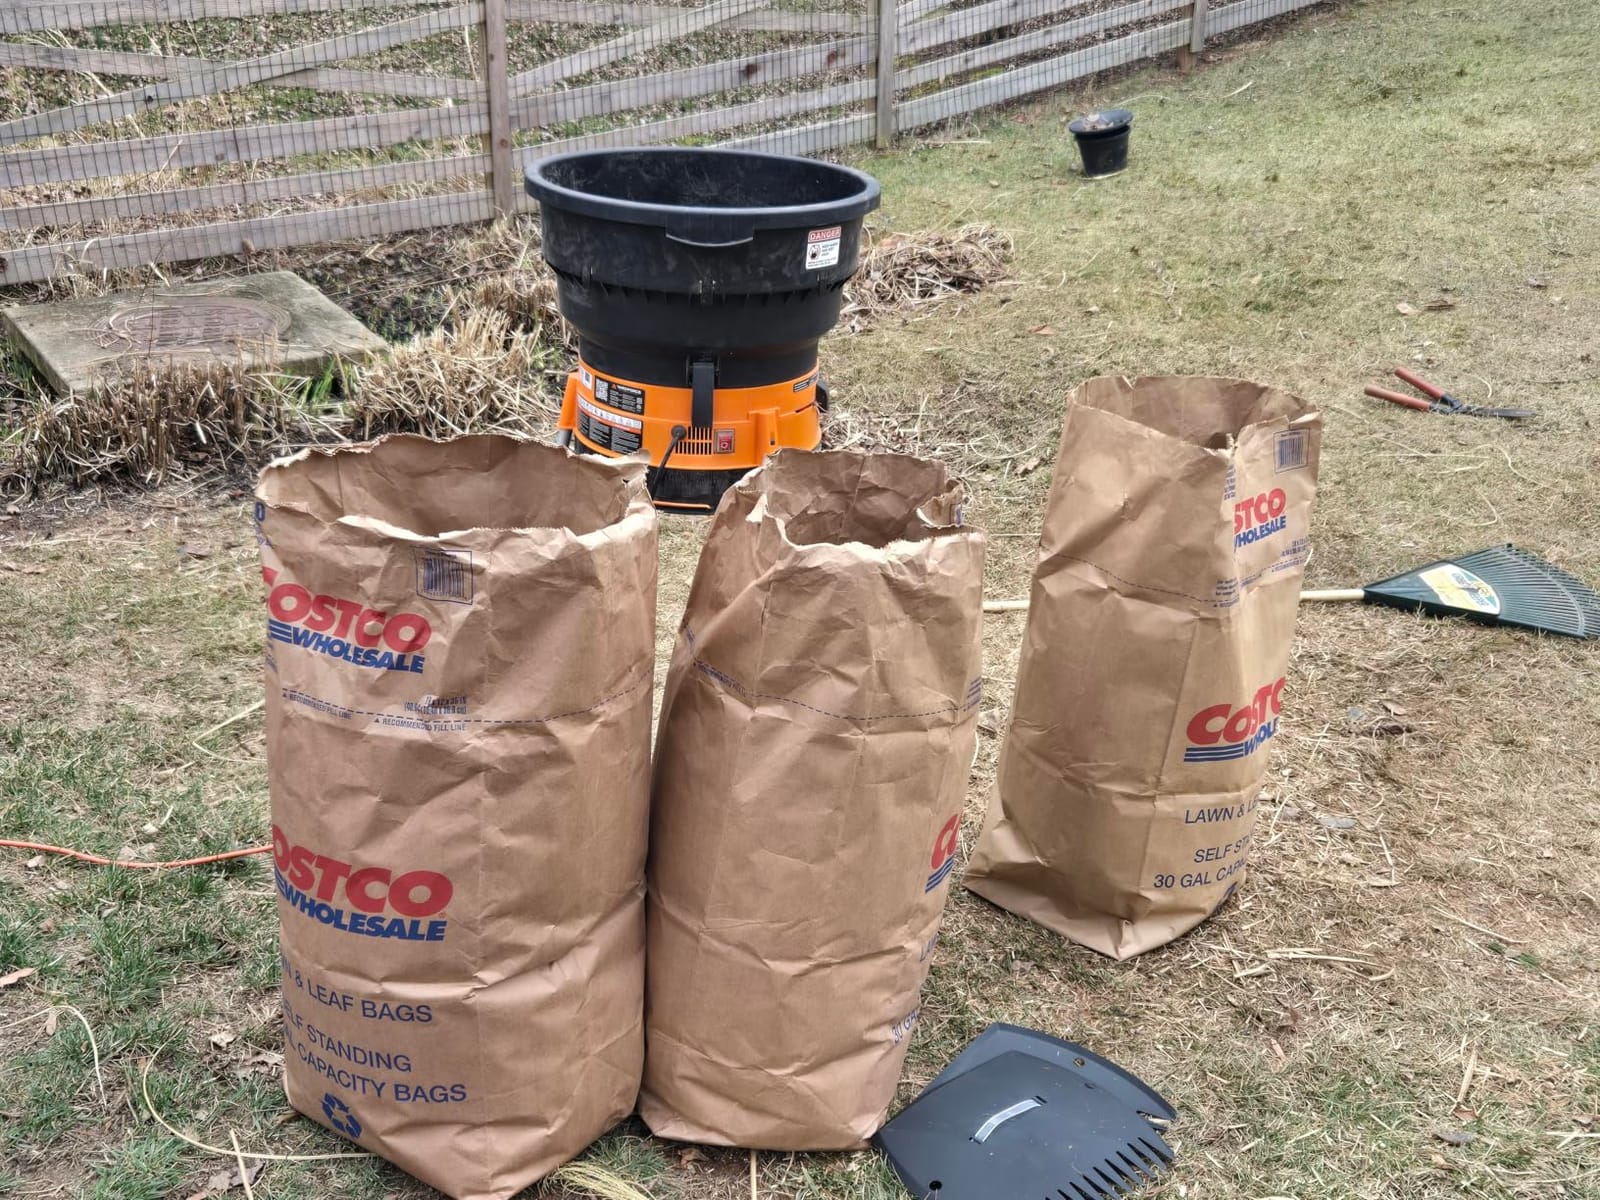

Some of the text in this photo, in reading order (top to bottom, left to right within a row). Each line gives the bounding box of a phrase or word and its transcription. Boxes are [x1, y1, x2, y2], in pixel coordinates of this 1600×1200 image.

[810, 229, 840, 241] DANGER
[1234, 488, 1286, 535] STCO
[1234, 515, 1286, 552] HOLESALE
[262, 566, 432, 653] OSTCO
[291, 627, 425, 674] WHOLESALE
[1186, 676, 1286, 746] COSTC
[1185, 806, 1234, 824] LAWN
[1237, 803, 1245, 818] &
[272, 824, 453, 918] OSTCO
[1194, 844, 1232, 863] SELF
[1153, 874, 1175, 889] 30
[1180, 871, 1211, 888] GAL
[287, 885, 448, 942] WHOLESALE
[295, 970, 433, 1023] & LEAF BAGS
[307, 1024, 412, 1072] STANDING
[298, 1043, 385, 1098] CAPACITY
[394, 1084, 467, 1103] BAGS
